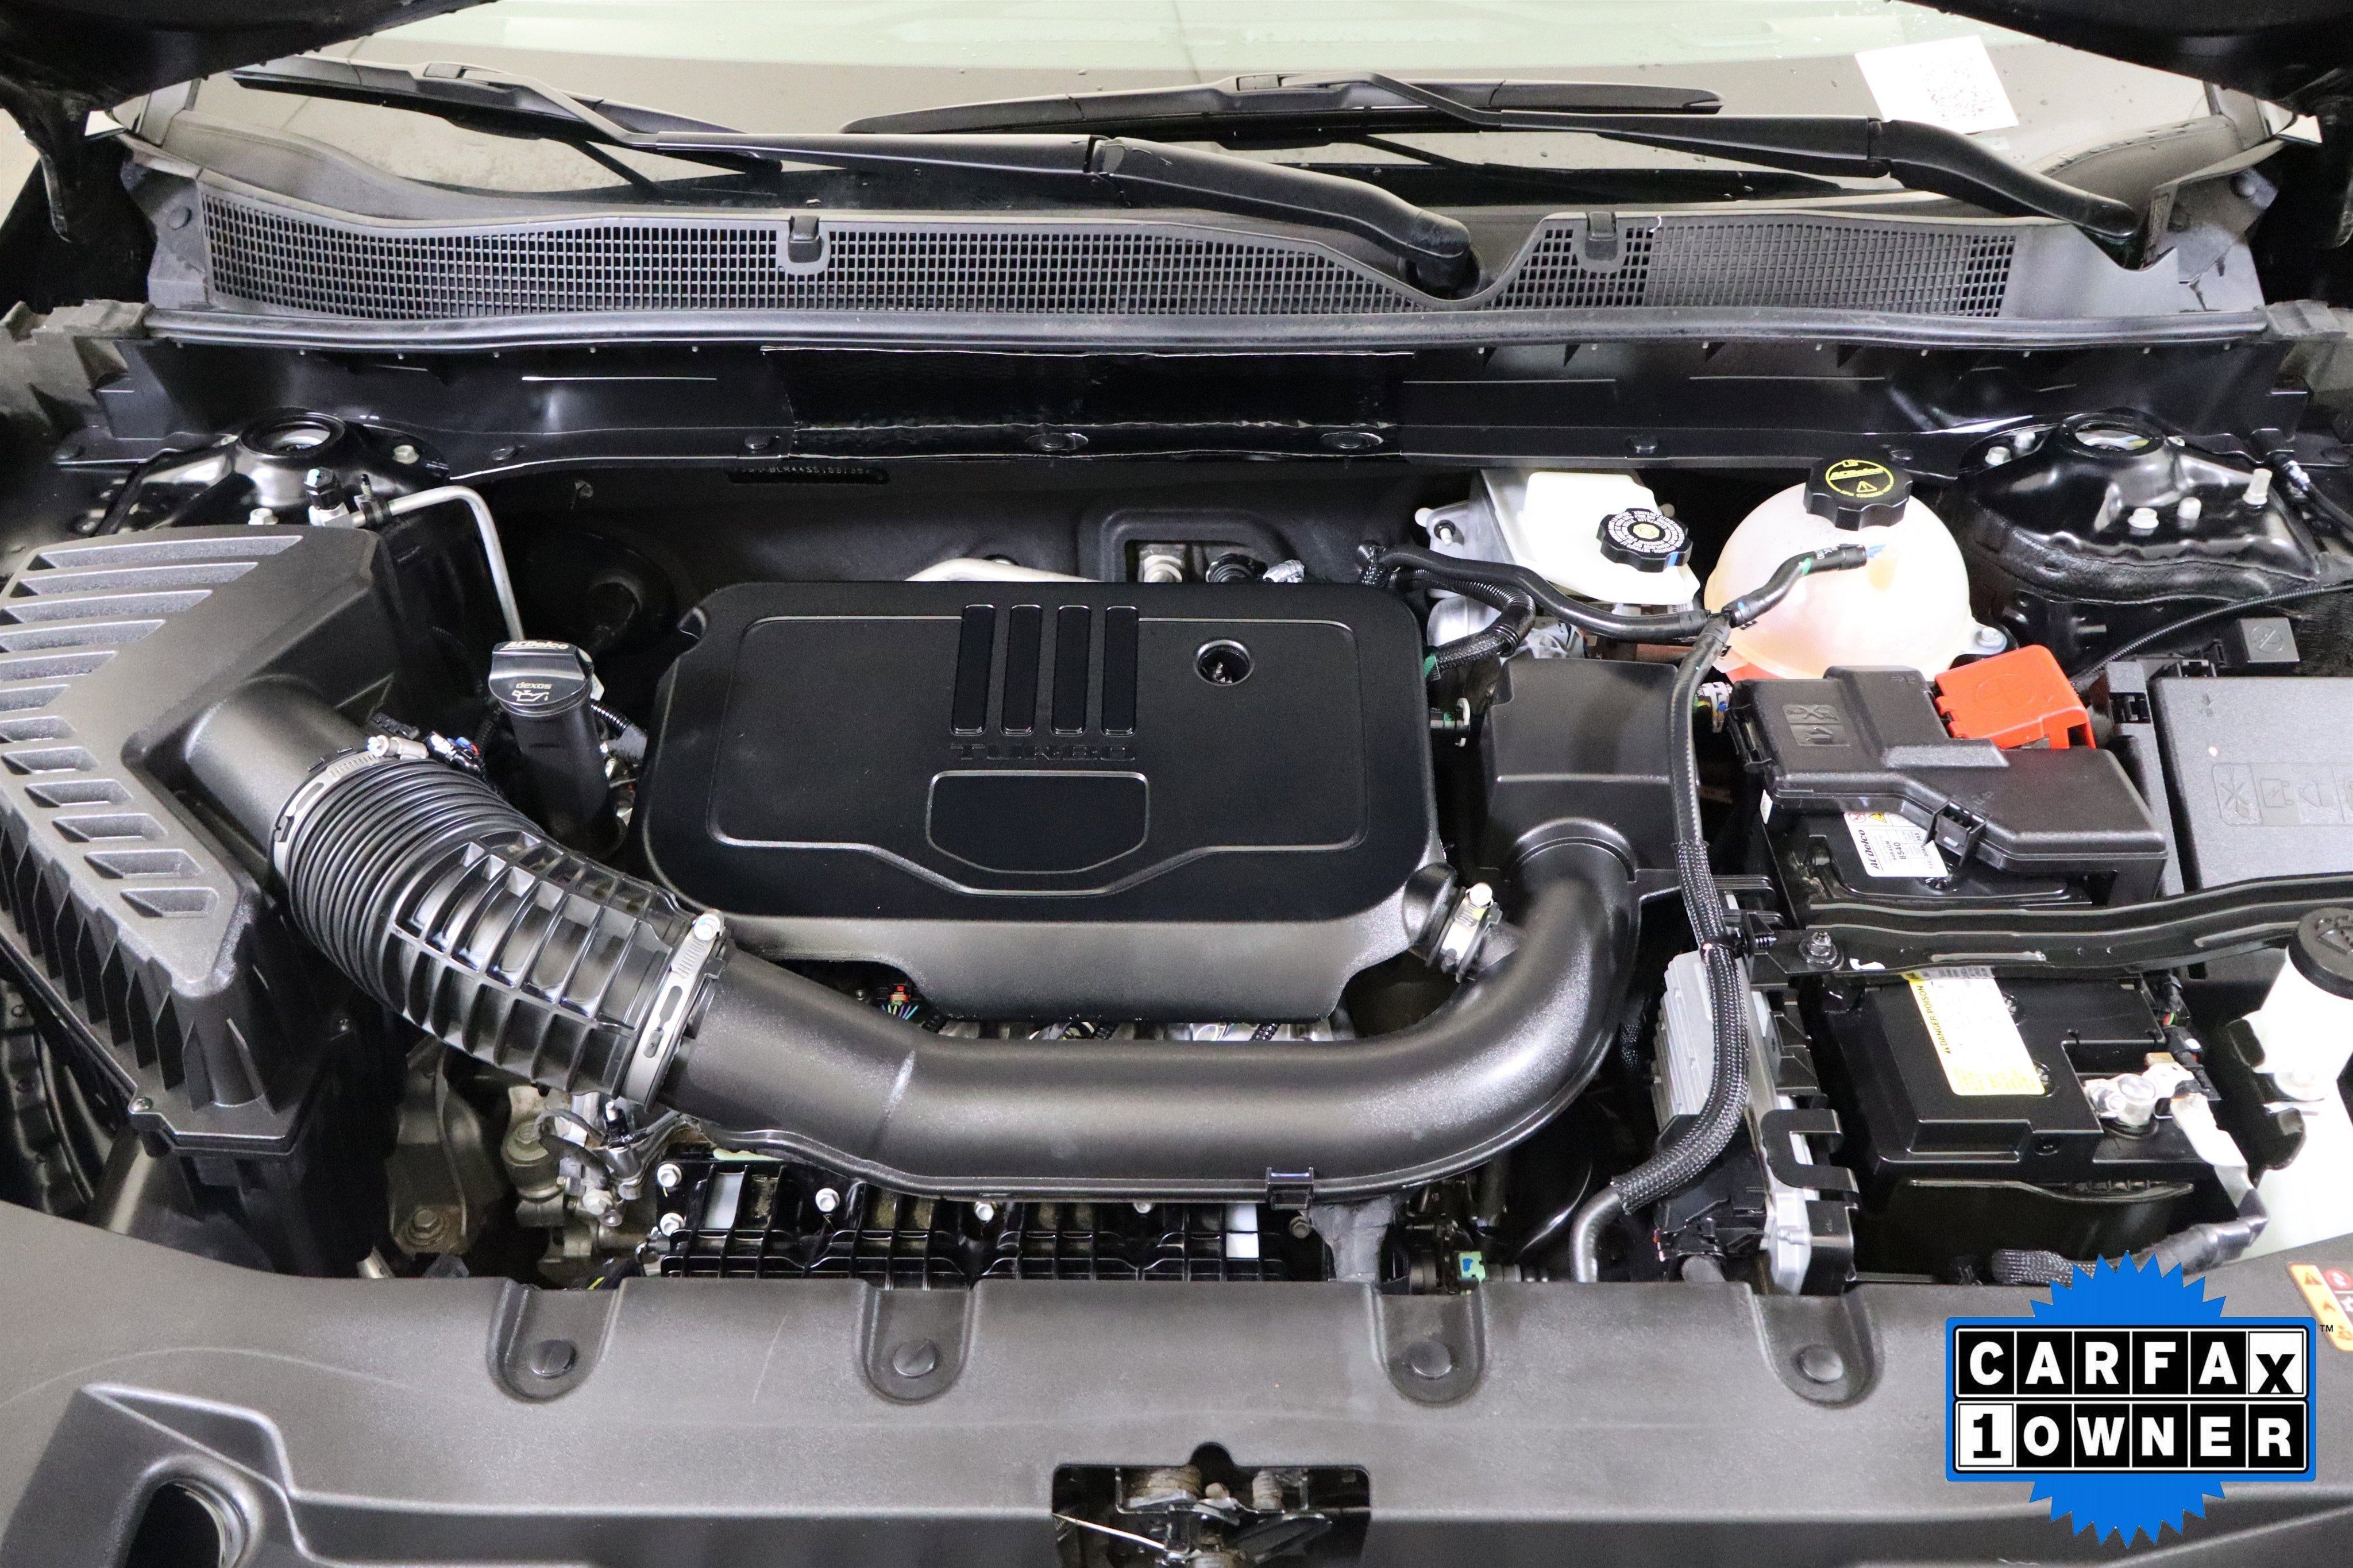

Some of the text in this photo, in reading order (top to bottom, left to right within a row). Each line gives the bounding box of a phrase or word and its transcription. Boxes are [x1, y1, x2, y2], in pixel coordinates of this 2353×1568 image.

[1829, 468, 1884, 480] ACDelco
[502, 640, 569, 650] ACDelco
[515, 681, 553, 689] dexos
[1858, 829, 1880, 870] ACDelco
[1893, 842, 1907, 860] 8540
[1916, 985, 1948, 1046] DANGER POISON
